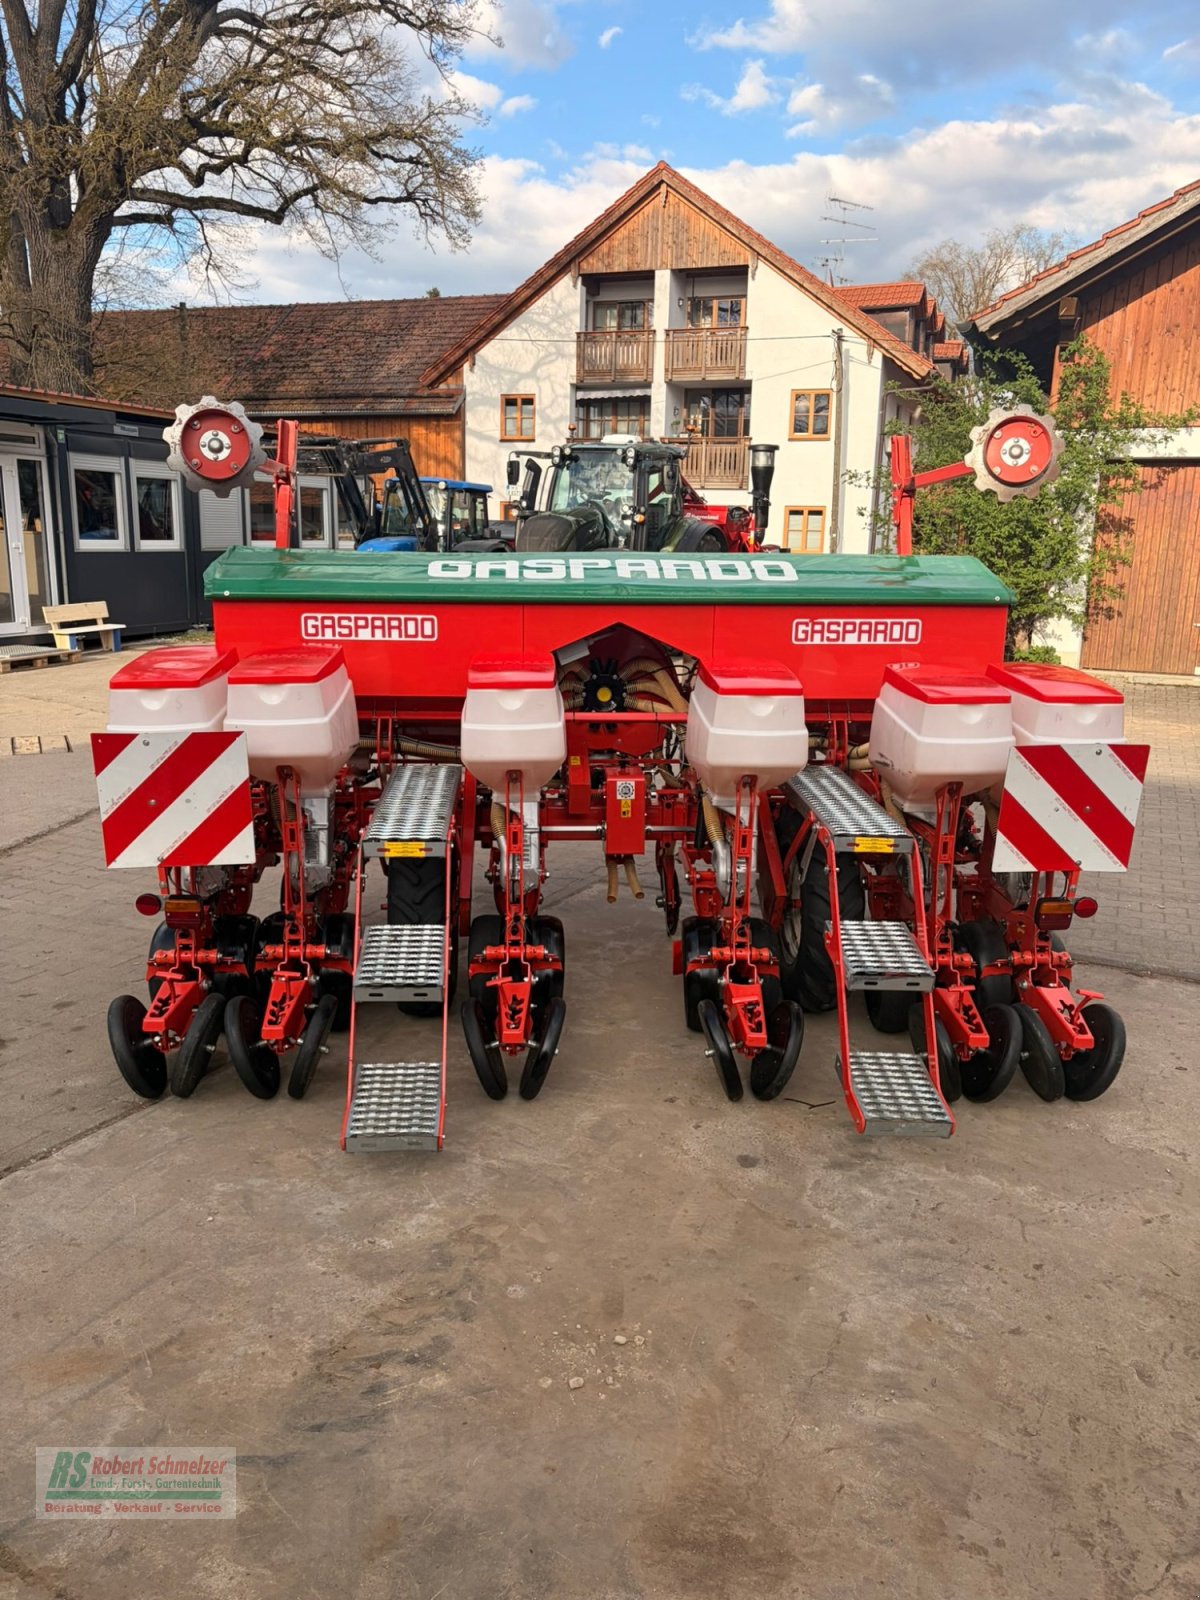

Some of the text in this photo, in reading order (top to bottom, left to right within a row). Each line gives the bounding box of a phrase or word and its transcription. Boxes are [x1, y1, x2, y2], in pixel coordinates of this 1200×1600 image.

[427, 558, 799, 582] GASPARDO
[303, 615, 436, 639] GASPARDO
[794, 621, 920, 642] GASPARDO
